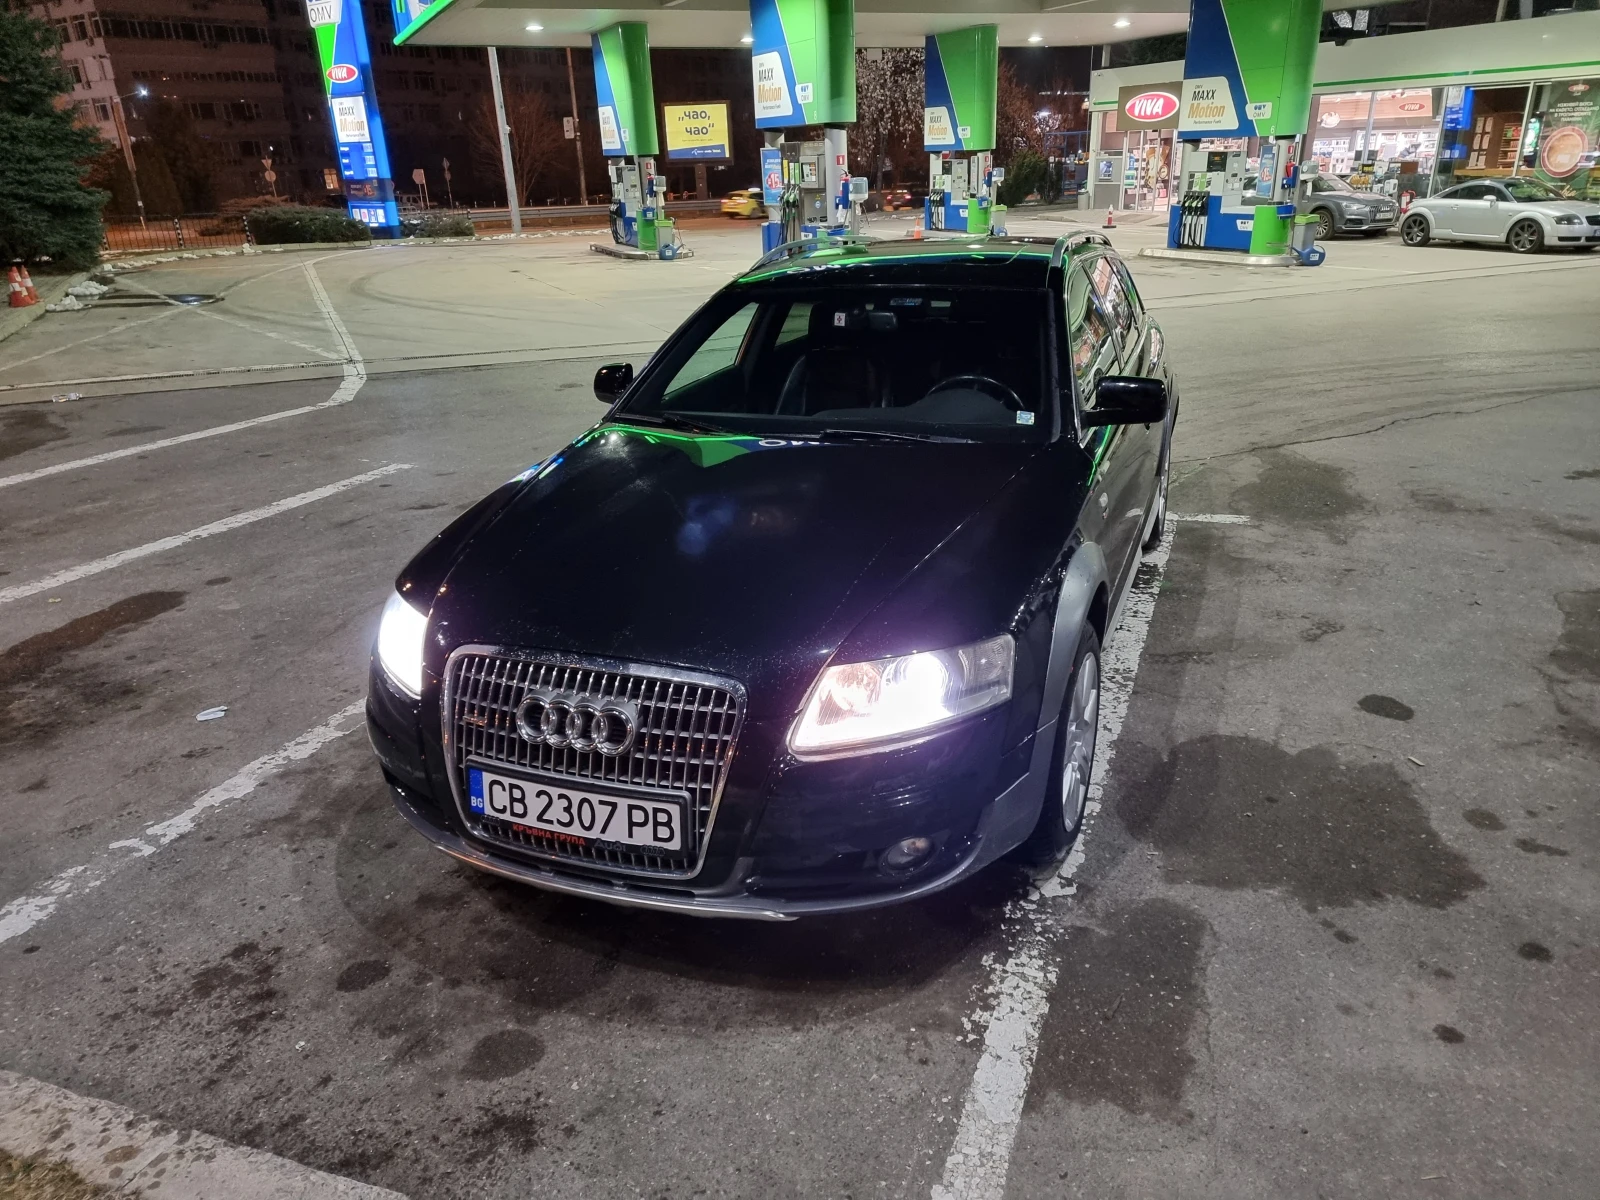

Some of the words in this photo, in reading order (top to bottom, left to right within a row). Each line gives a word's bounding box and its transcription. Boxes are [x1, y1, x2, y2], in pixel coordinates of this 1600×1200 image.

[309, 5, 332, 22] OMV
[331, 67, 348, 80] VIVA
[758, 67, 774, 82] MAXX
[757, 83, 782, 103] Motion
[1191, 89, 1217, 102] MAXX
[338, 106, 355, 117] MAXX
[1134, 98, 1165, 117] VIVA
[1187, 101, 1225, 119] Motion
[1404, 103, 1421, 111] VIVA
[340, 117, 365, 132] Motion
[1270, 125, 1275, 134] 6
[470, 796, 484, 808] BG
[488, 779, 528, 819] CB
[535, 789, 618, 835] 2307
[627, 803, 675, 843] PB
[511, 823, 552, 839] КРЪВНА
[553, 832, 586, 847] ГРУПА
[594, 838, 628, 852] Audi
